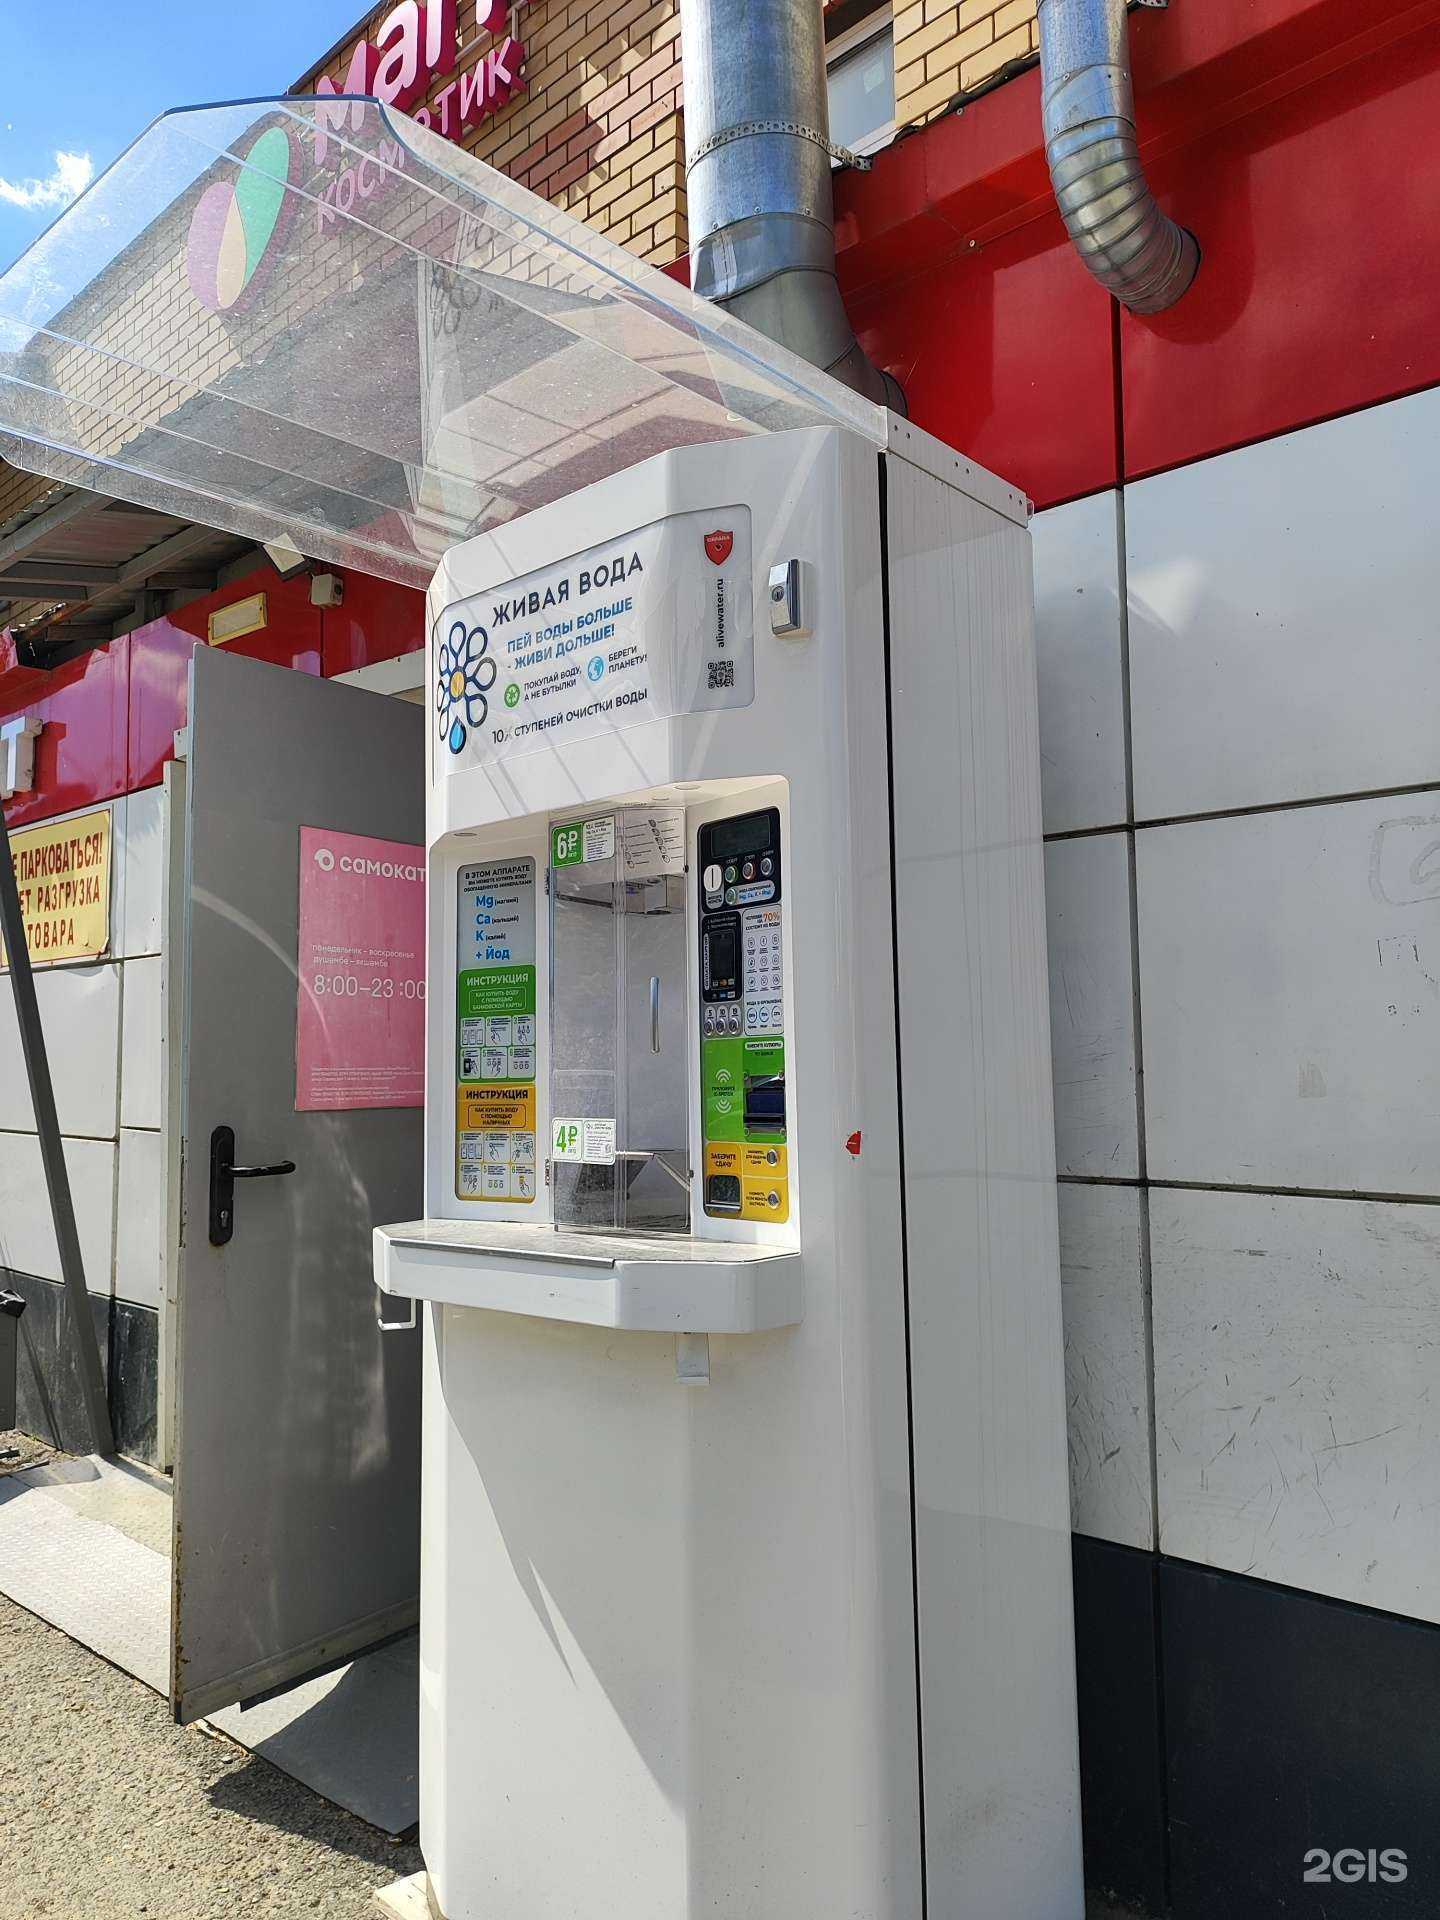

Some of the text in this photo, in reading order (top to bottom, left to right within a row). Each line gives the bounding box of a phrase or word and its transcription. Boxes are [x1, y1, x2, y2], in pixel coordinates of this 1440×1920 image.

[492, 552, 643, 627] ЖИВАЯ ВОДА
[507, 597, 633, 653] ПЕЙ ВОДЫ БОЛЬШЕ
[716, 578, 725, 649] alivewater.ru
[514, 647, 552, 670] ЖИВИ
[556, 624, 615, 658] ДОЛЬШЕ!
[608, 645, 637, 662] БЕРЕГИ
[608, 654, 648, 674] ПЛАНЕТУ!
[524, 666, 582, 691] ПОКУПАЙ ВОДУ,
[524, 678, 576, 701] А НЕ БУТЫЛКИ
[514, 712, 563, 737] СТУПЕНЕЙ
[566, 700, 613, 722] ОЧИСТКИ
[616, 688, 648, 708] ВОДЫ
[20, 832, 103, 882] ПАРКОВАТЬСЯ!
[340, 856, 426, 882] самокат
[471, 870, 491, 879] ЭТОМ
[492, 865, 531, 876] АППАРАТЕ
[38, 875, 100, 913] РАЗГРУЗКА
[476, 895, 494, 908] Mg
[476, 914, 490, 925] Ca
[28, 918, 74, 950] ТОВАРА
[486, 945, 510, 960] Йод
[466, 973, 528, 987] ИНСТРУКЦИЯ
[466, 1090, 528, 1100] ИНСТРУКЦИЯ
